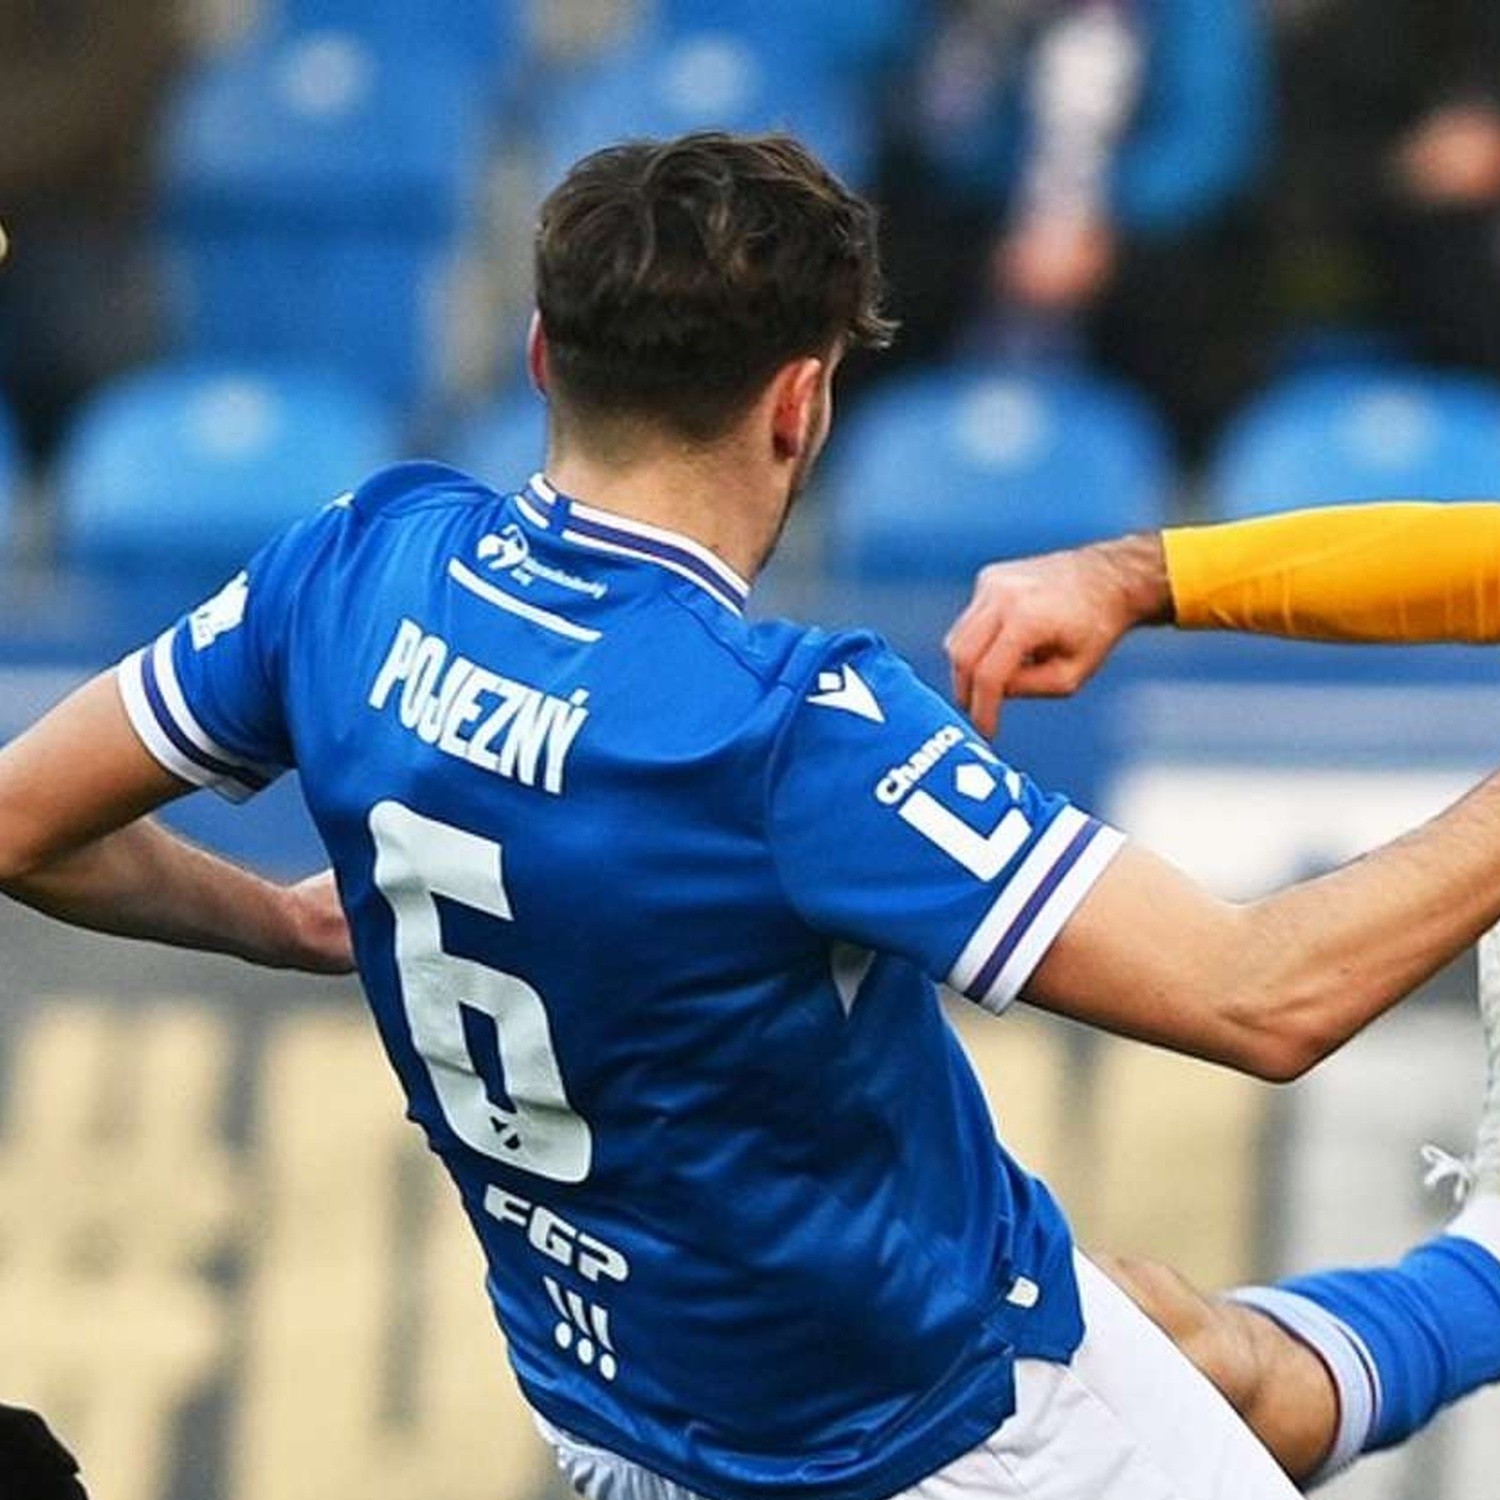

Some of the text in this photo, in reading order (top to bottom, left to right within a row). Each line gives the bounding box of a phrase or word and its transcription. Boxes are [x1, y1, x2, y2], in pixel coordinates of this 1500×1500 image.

[369, 617, 589, 795] POJEZNÝ
[367, 800, 592, 1183] 6
[484, 1183, 629, 1282] FGP
